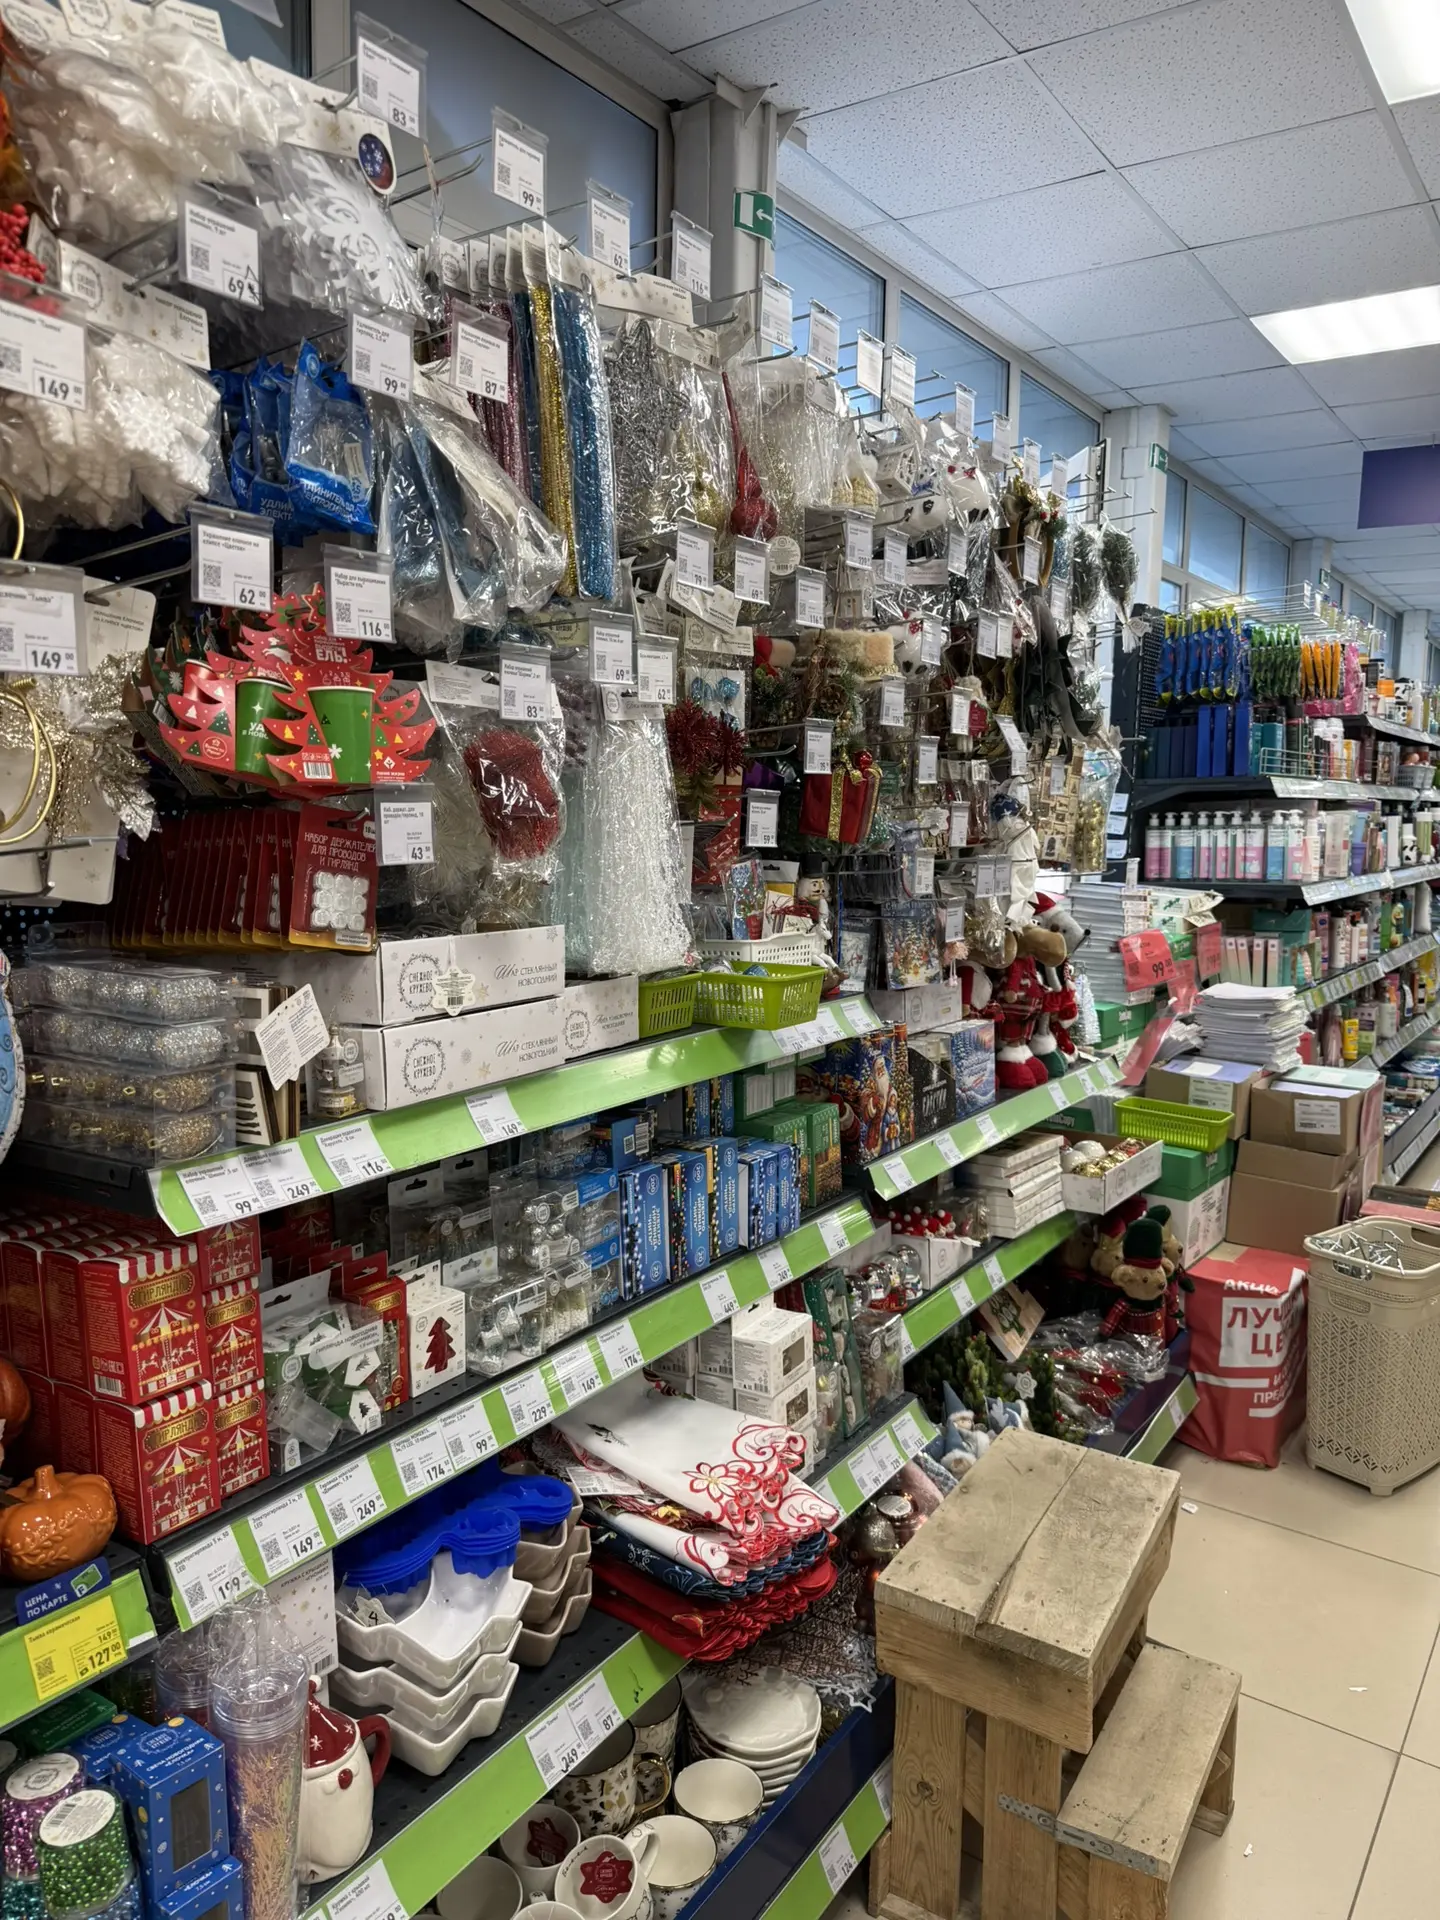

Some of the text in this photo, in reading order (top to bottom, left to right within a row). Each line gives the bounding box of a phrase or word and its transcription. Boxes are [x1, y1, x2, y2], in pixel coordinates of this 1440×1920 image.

[393, 108, 406, 126] 83
[523, 191, 535, 207] 99
[614, 253, 623, 268] 62
[228, 276, 244, 300] 69
[692, 279, 704, 294] 116
[39, 376, 70, 400] 149
[384, 377, 398, 394] 99
[485, 381, 497, 395] 87
[239, 587, 255, 605] 62
[362, 621, 382, 637] 116
[31, 650, 62, 670] 149
[615, 669, 625, 681] 69
[657, 690, 666, 700] 62
[526, 705, 538, 719] 83
[304, 832, 329, 844] НАБОР
[311, 843, 366, 863] ДЛЯ ПРОВОДОВ
[411, 847, 423, 861] 43
[320, 857, 359, 872] И ГИРЛЯНД
[408, 970, 433, 983] СНЕЖНОЕ
[1152, 961, 1165, 978] 99
[409, 982, 433, 995] КРУЖЕВО
[518, 973, 558, 990] НОВОГОДНИЙ
[413, 1053, 436, 1068] СНЕЖНОЕ
[518, 1046, 558, 1062] НОВОГОДНИЙ
[413, 1065, 436, 1080] КРУЖЕВО
[501, 1123, 519, 1136] 149
[362, 1161, 384, 1176] 116
[287, 1184, 311, 1199] 249
[235, 1200, 252, 1215] 99
[723, 1302, 735, 1314] 449
[624, 1354, 639, 1369] 174
[581, 1378, 596, 1393] 149
[531, 1406, 547, 1424] 229
[476, 1439, 488, 1454] 99
[426, 1464, 446, 1481] 174
[356, 1500, 377, 1521] 249
[253, 1521, 263, 1529] LED
[292, 1537, 314, 1558] 149
[176, 1565, 187, 1575] LED
[24, 1592, 49, 1608] ЦЕНА
[27, 1594, 69, 1618] ПО КАРТЕ
[98, 1632, 112, 1644] 149
[88, 1642, 122, 1669] 127 00
[602, 1715, 615, 1731] 87
[561, 1749, 579, 1766] 249
[841, 1860, 854, 1877] 124
